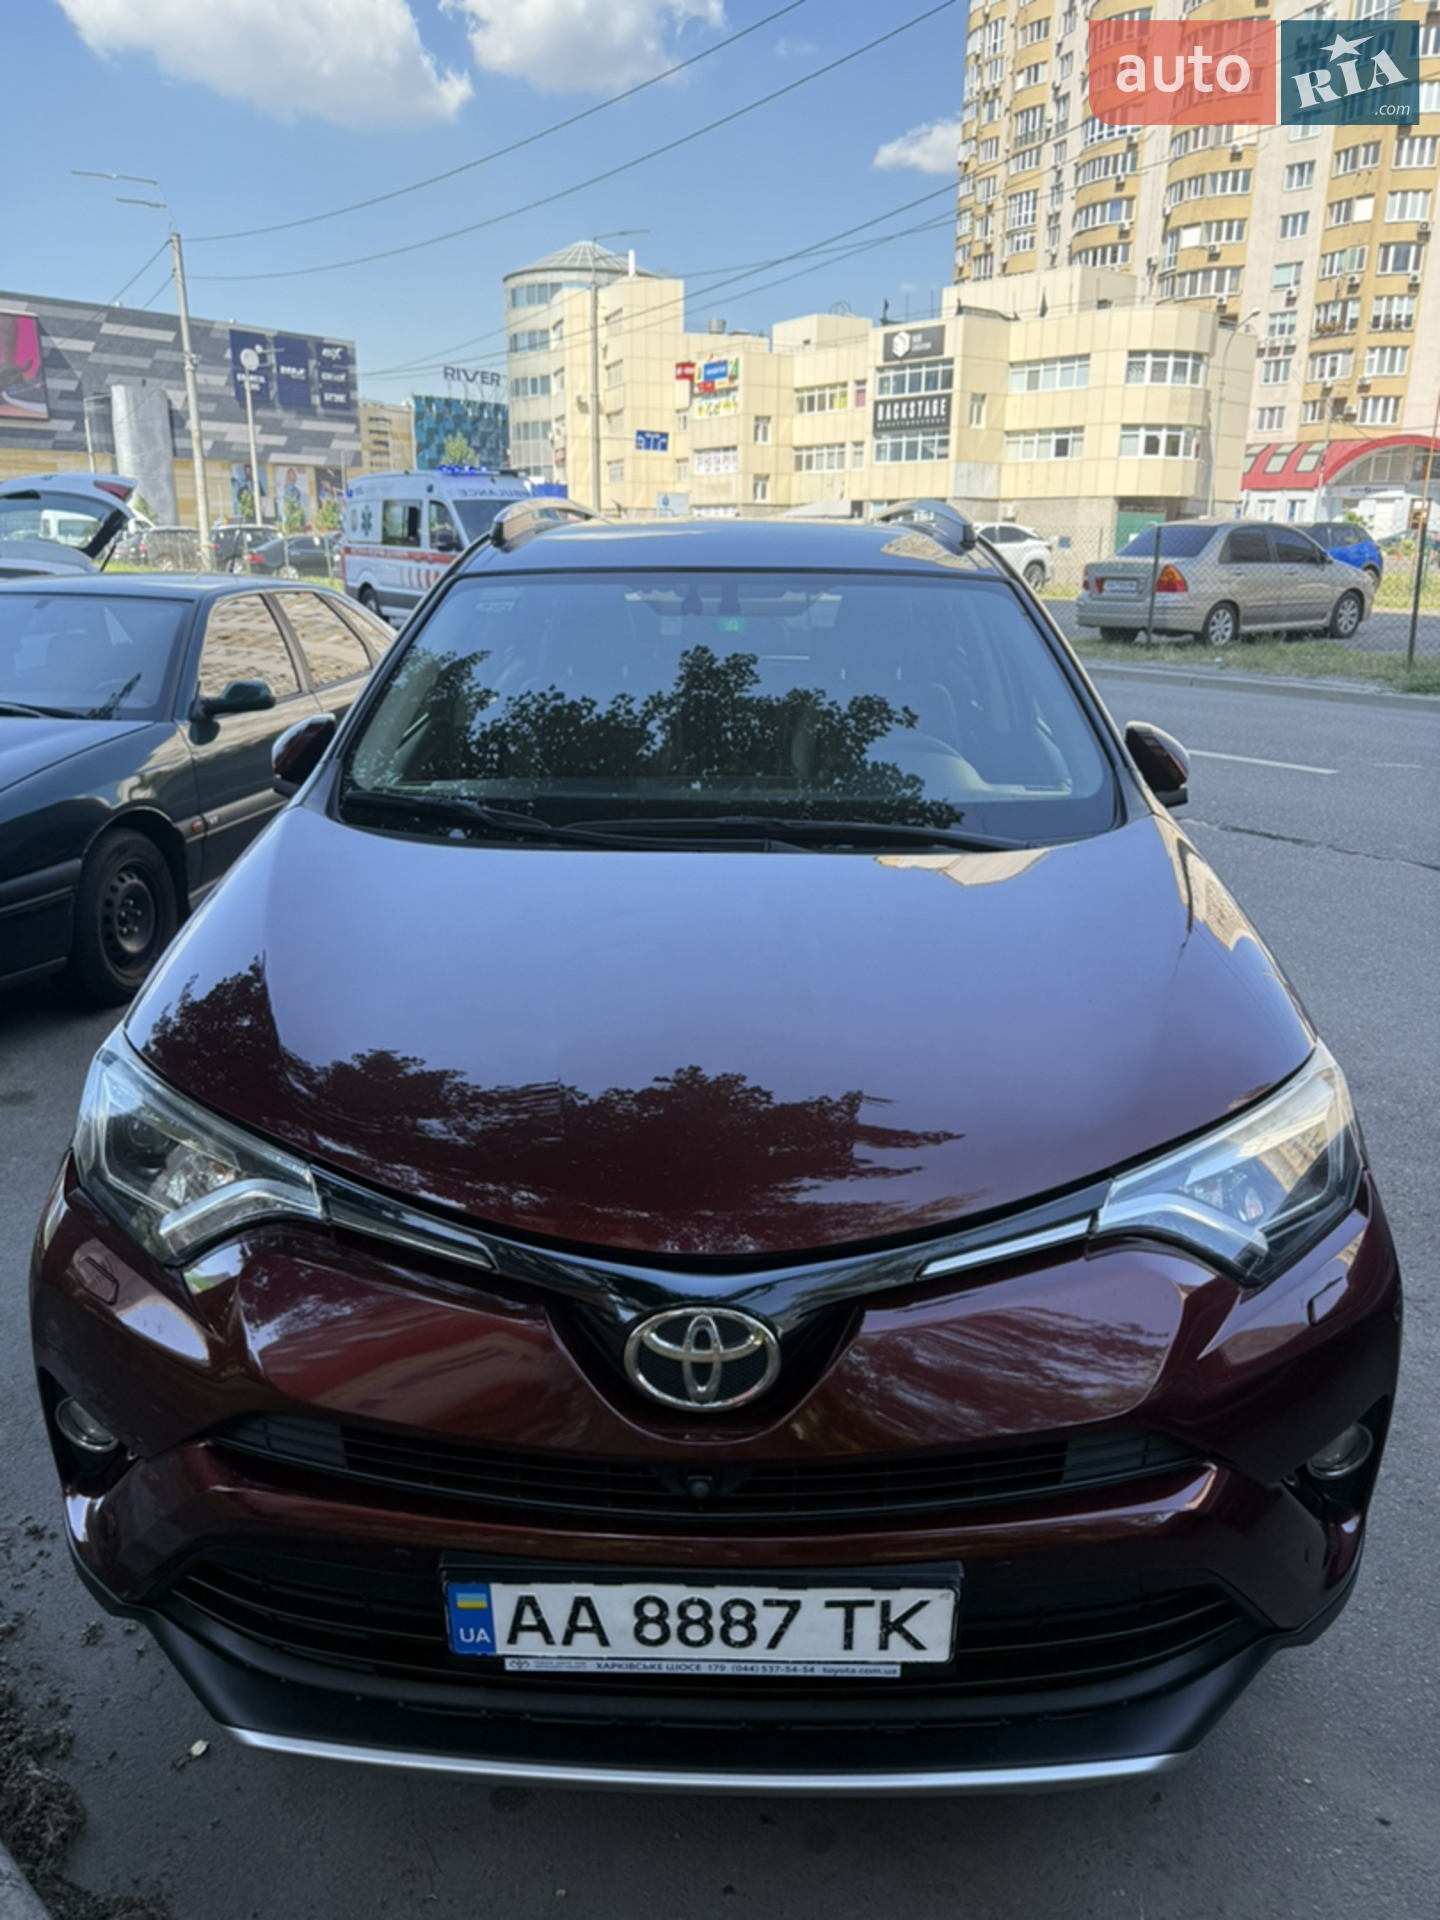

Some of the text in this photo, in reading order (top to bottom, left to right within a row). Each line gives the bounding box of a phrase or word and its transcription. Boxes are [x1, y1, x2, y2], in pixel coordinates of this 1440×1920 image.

[443, 365, 501, 387] RIVER
[877, 398, 947, 421] BACKSTAGE
[506, 1594, 932, 1651] AA 8887 TK
[459, 1628, 491, 1643] UA
[666, 1663, 701, 1672] ШОСЕ
[708, 1664, 726, 1672] 179
[731, 1664, 759, 1673] (044)
[761, 1665, 815, 1674] 537-54-54
[822, 1666, 898, 1676] toyota.com.ua
